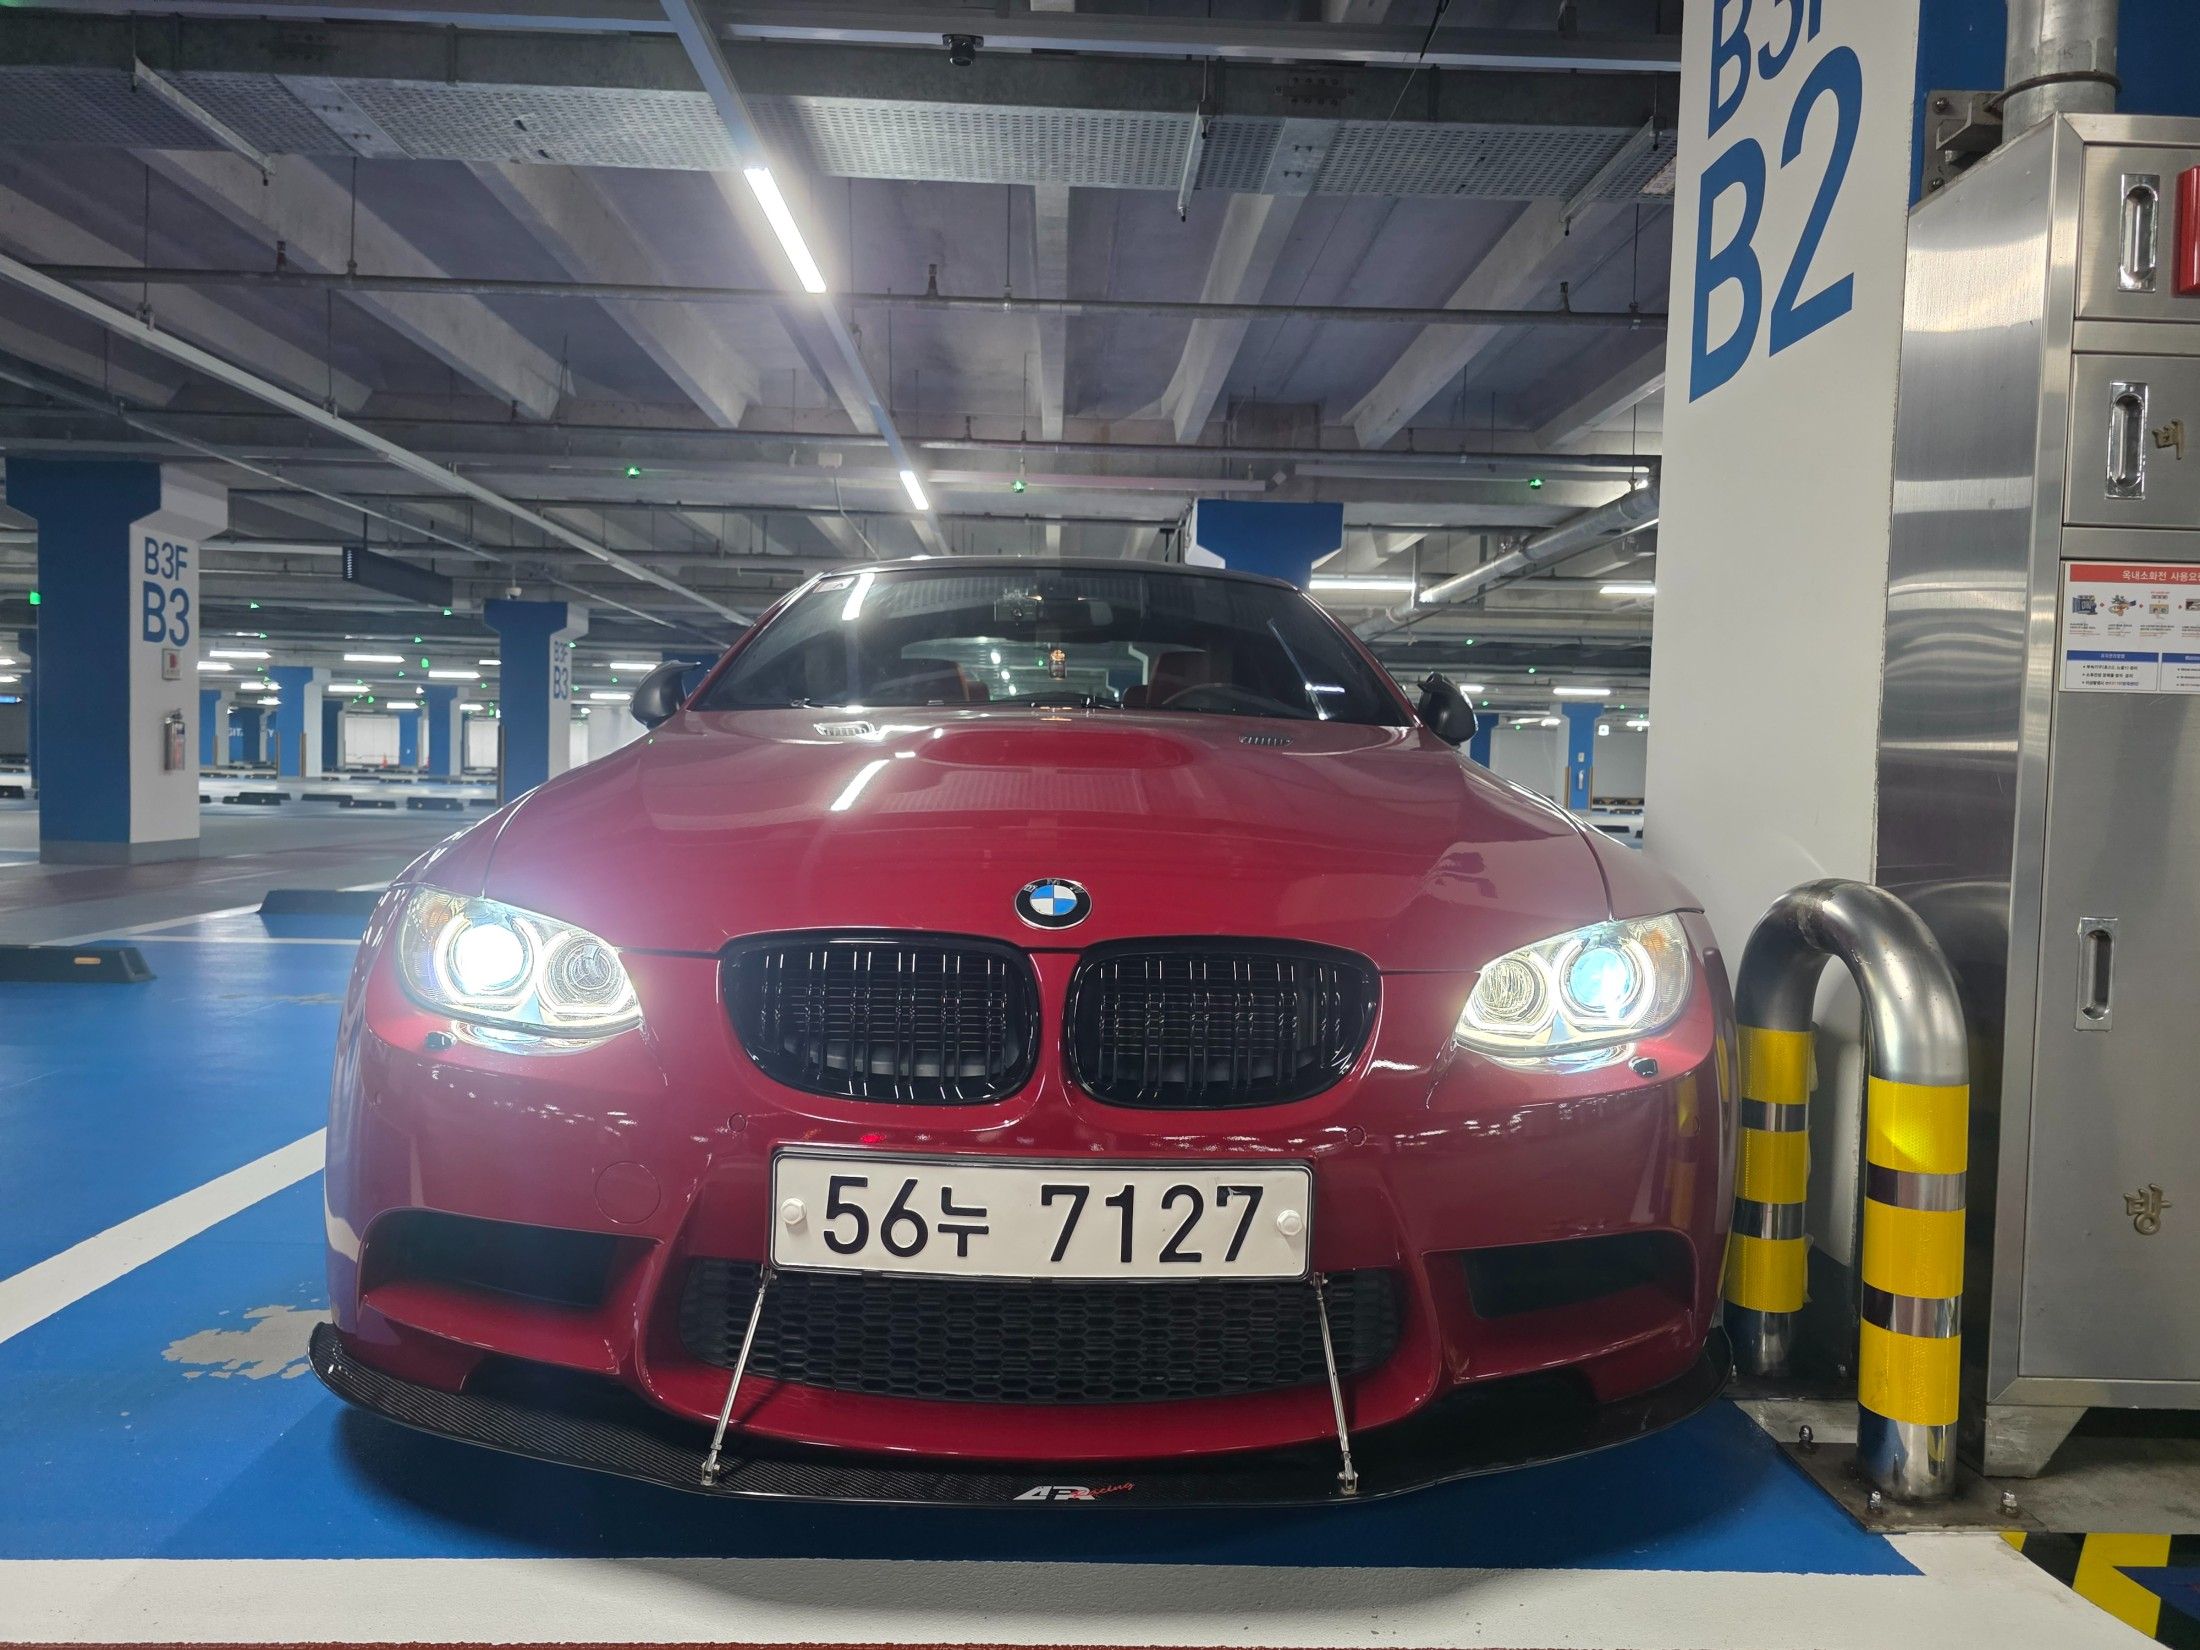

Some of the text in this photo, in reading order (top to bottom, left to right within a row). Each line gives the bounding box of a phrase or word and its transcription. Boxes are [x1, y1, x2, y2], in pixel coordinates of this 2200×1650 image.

[1689, 46, 1862, 404] B2
[144, 536, 188, 580] B3F
[143, 580, 189, 647] B3
[823, 1175, 1264, 1264] 56누 7127
[2123, 1183, 2172, 1236] 방
